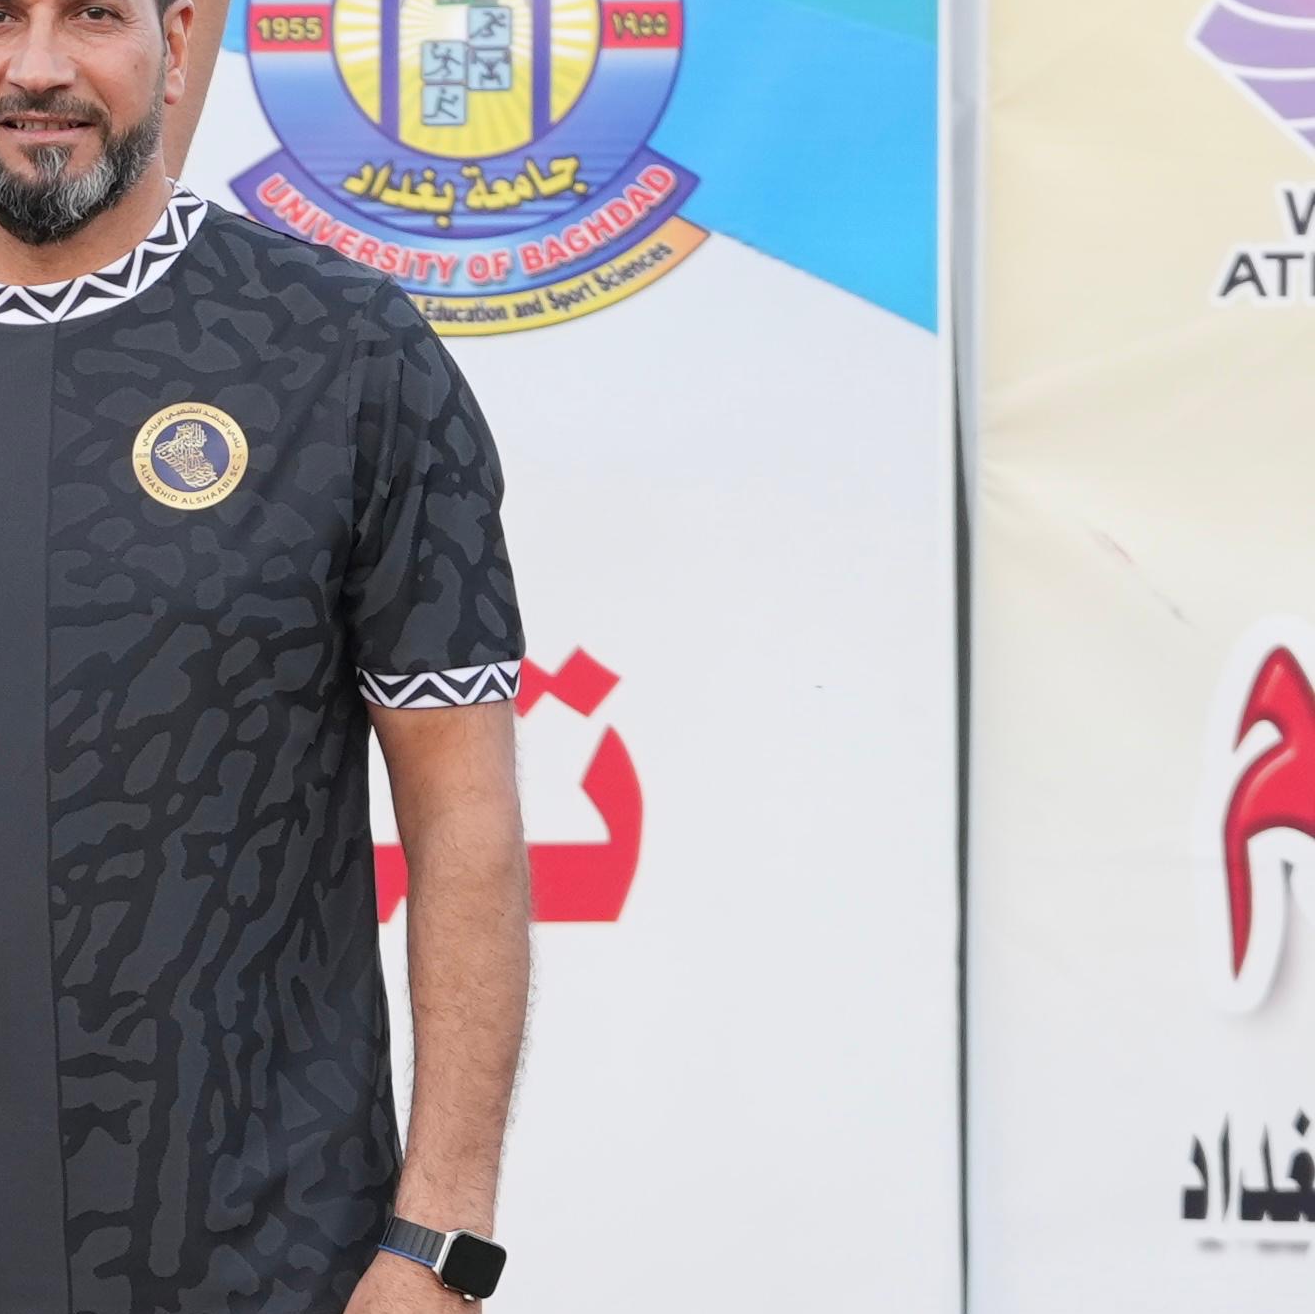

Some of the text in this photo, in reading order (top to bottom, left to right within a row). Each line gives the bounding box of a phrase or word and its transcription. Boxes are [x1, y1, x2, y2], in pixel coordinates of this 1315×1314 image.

[256, 16, 323, 42] 1955
[257, 165, 677, 285] UNIVERSITY OF BAGHDAD
[344, 154, 588, 230] جامعة بغداد
[424, 242, 673, 322] Education and Sport Sciences
[138, 463, 178, 503] ALHASHID
[180, 478, 233, 505] ALSHAABI
